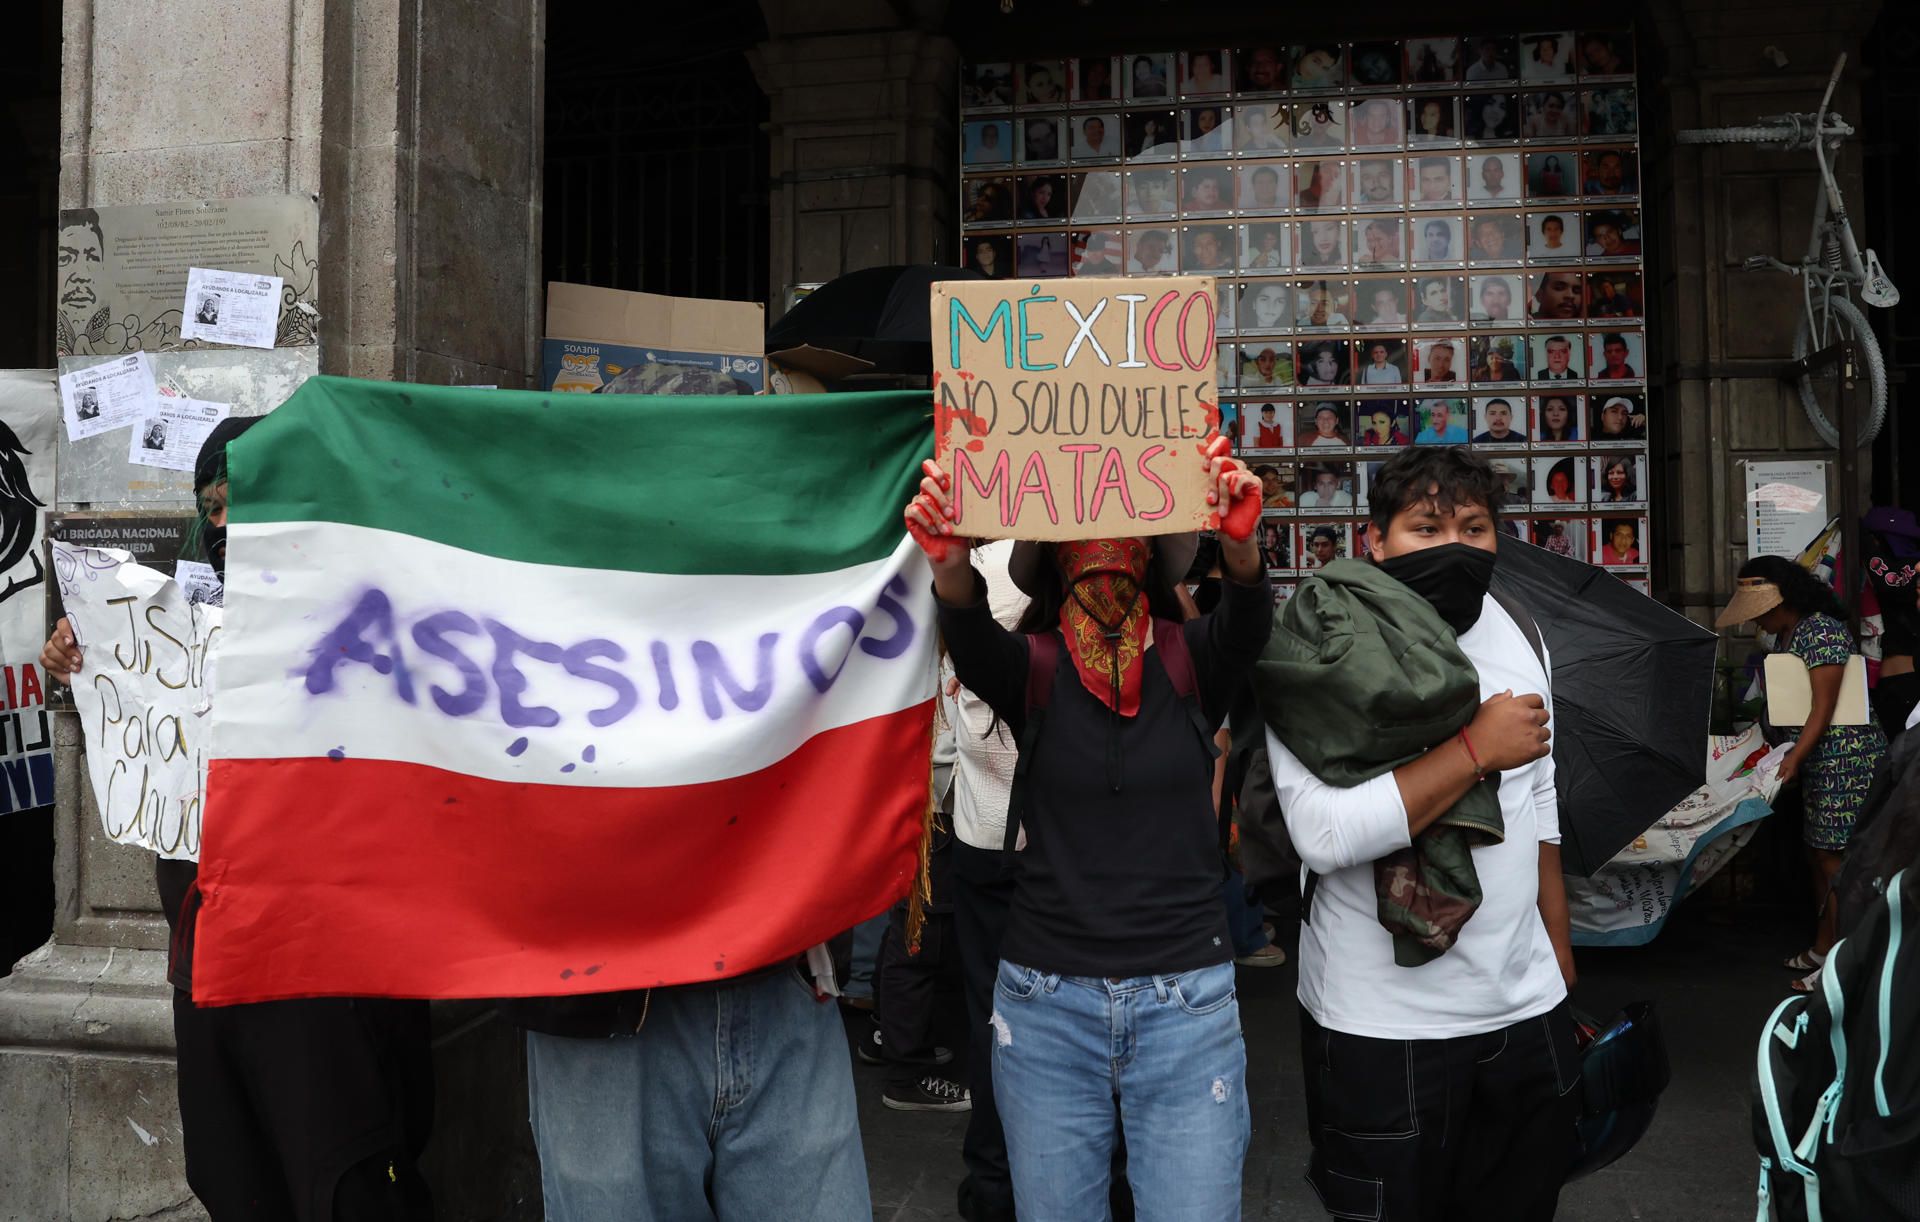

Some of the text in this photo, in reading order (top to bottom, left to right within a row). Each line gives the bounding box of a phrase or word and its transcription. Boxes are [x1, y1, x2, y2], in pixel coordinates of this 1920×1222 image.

[564, 344, 600, 355] HUEVOS
[950, 284, 1215, 371] MÉXICO
[561, 354, 601, 373] 360
[940, 380, 1213, 440] NO SOLO DUELES
[953, 444, 1175, 527] MATAS
[70, 529, 120, 539] BRIGADA
[122, 528, 179, 539] NACIONAL
[303, 574, 916, 728] ASESINOS
[0, 664, 44, 711] IA
